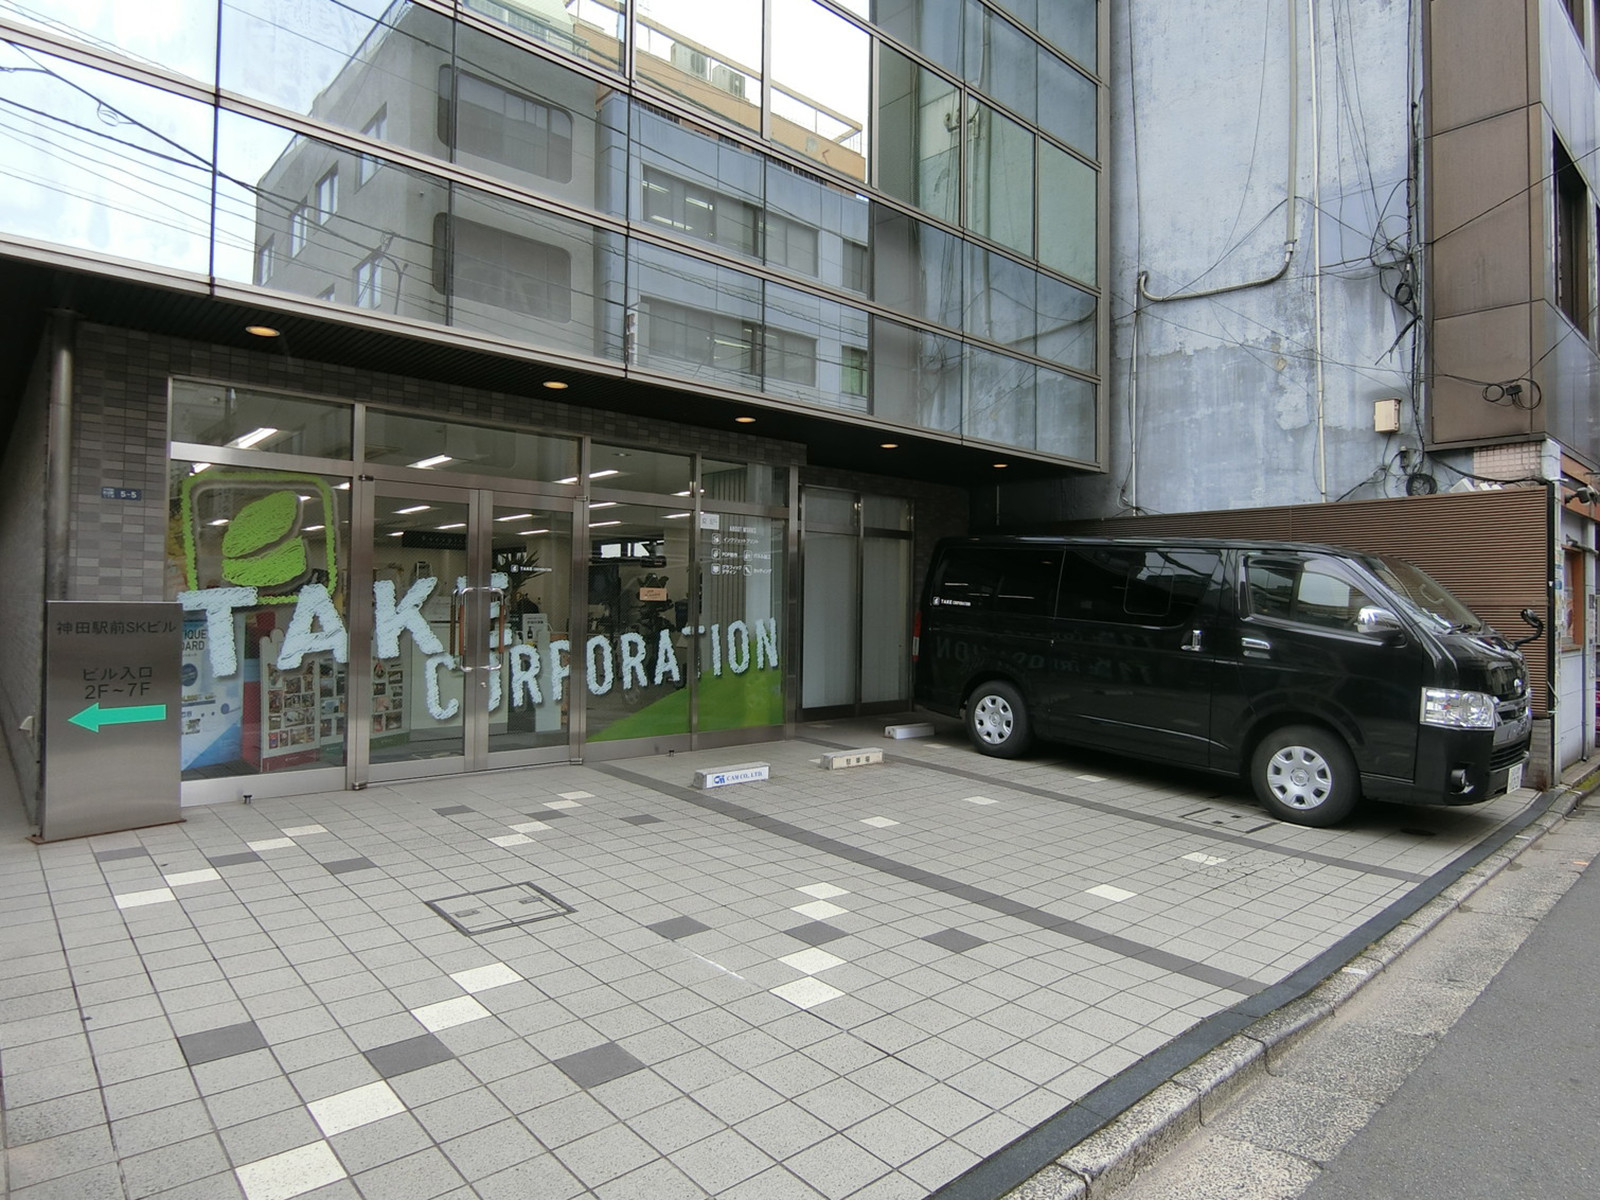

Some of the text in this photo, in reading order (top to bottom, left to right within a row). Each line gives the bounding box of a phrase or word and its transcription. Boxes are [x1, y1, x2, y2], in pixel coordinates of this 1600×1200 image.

[120, 490, 137, 500] 5-5
[57, 621, 177, 635] 神田駅前SKビル
[83, 666, 153, 681] ビル入口
